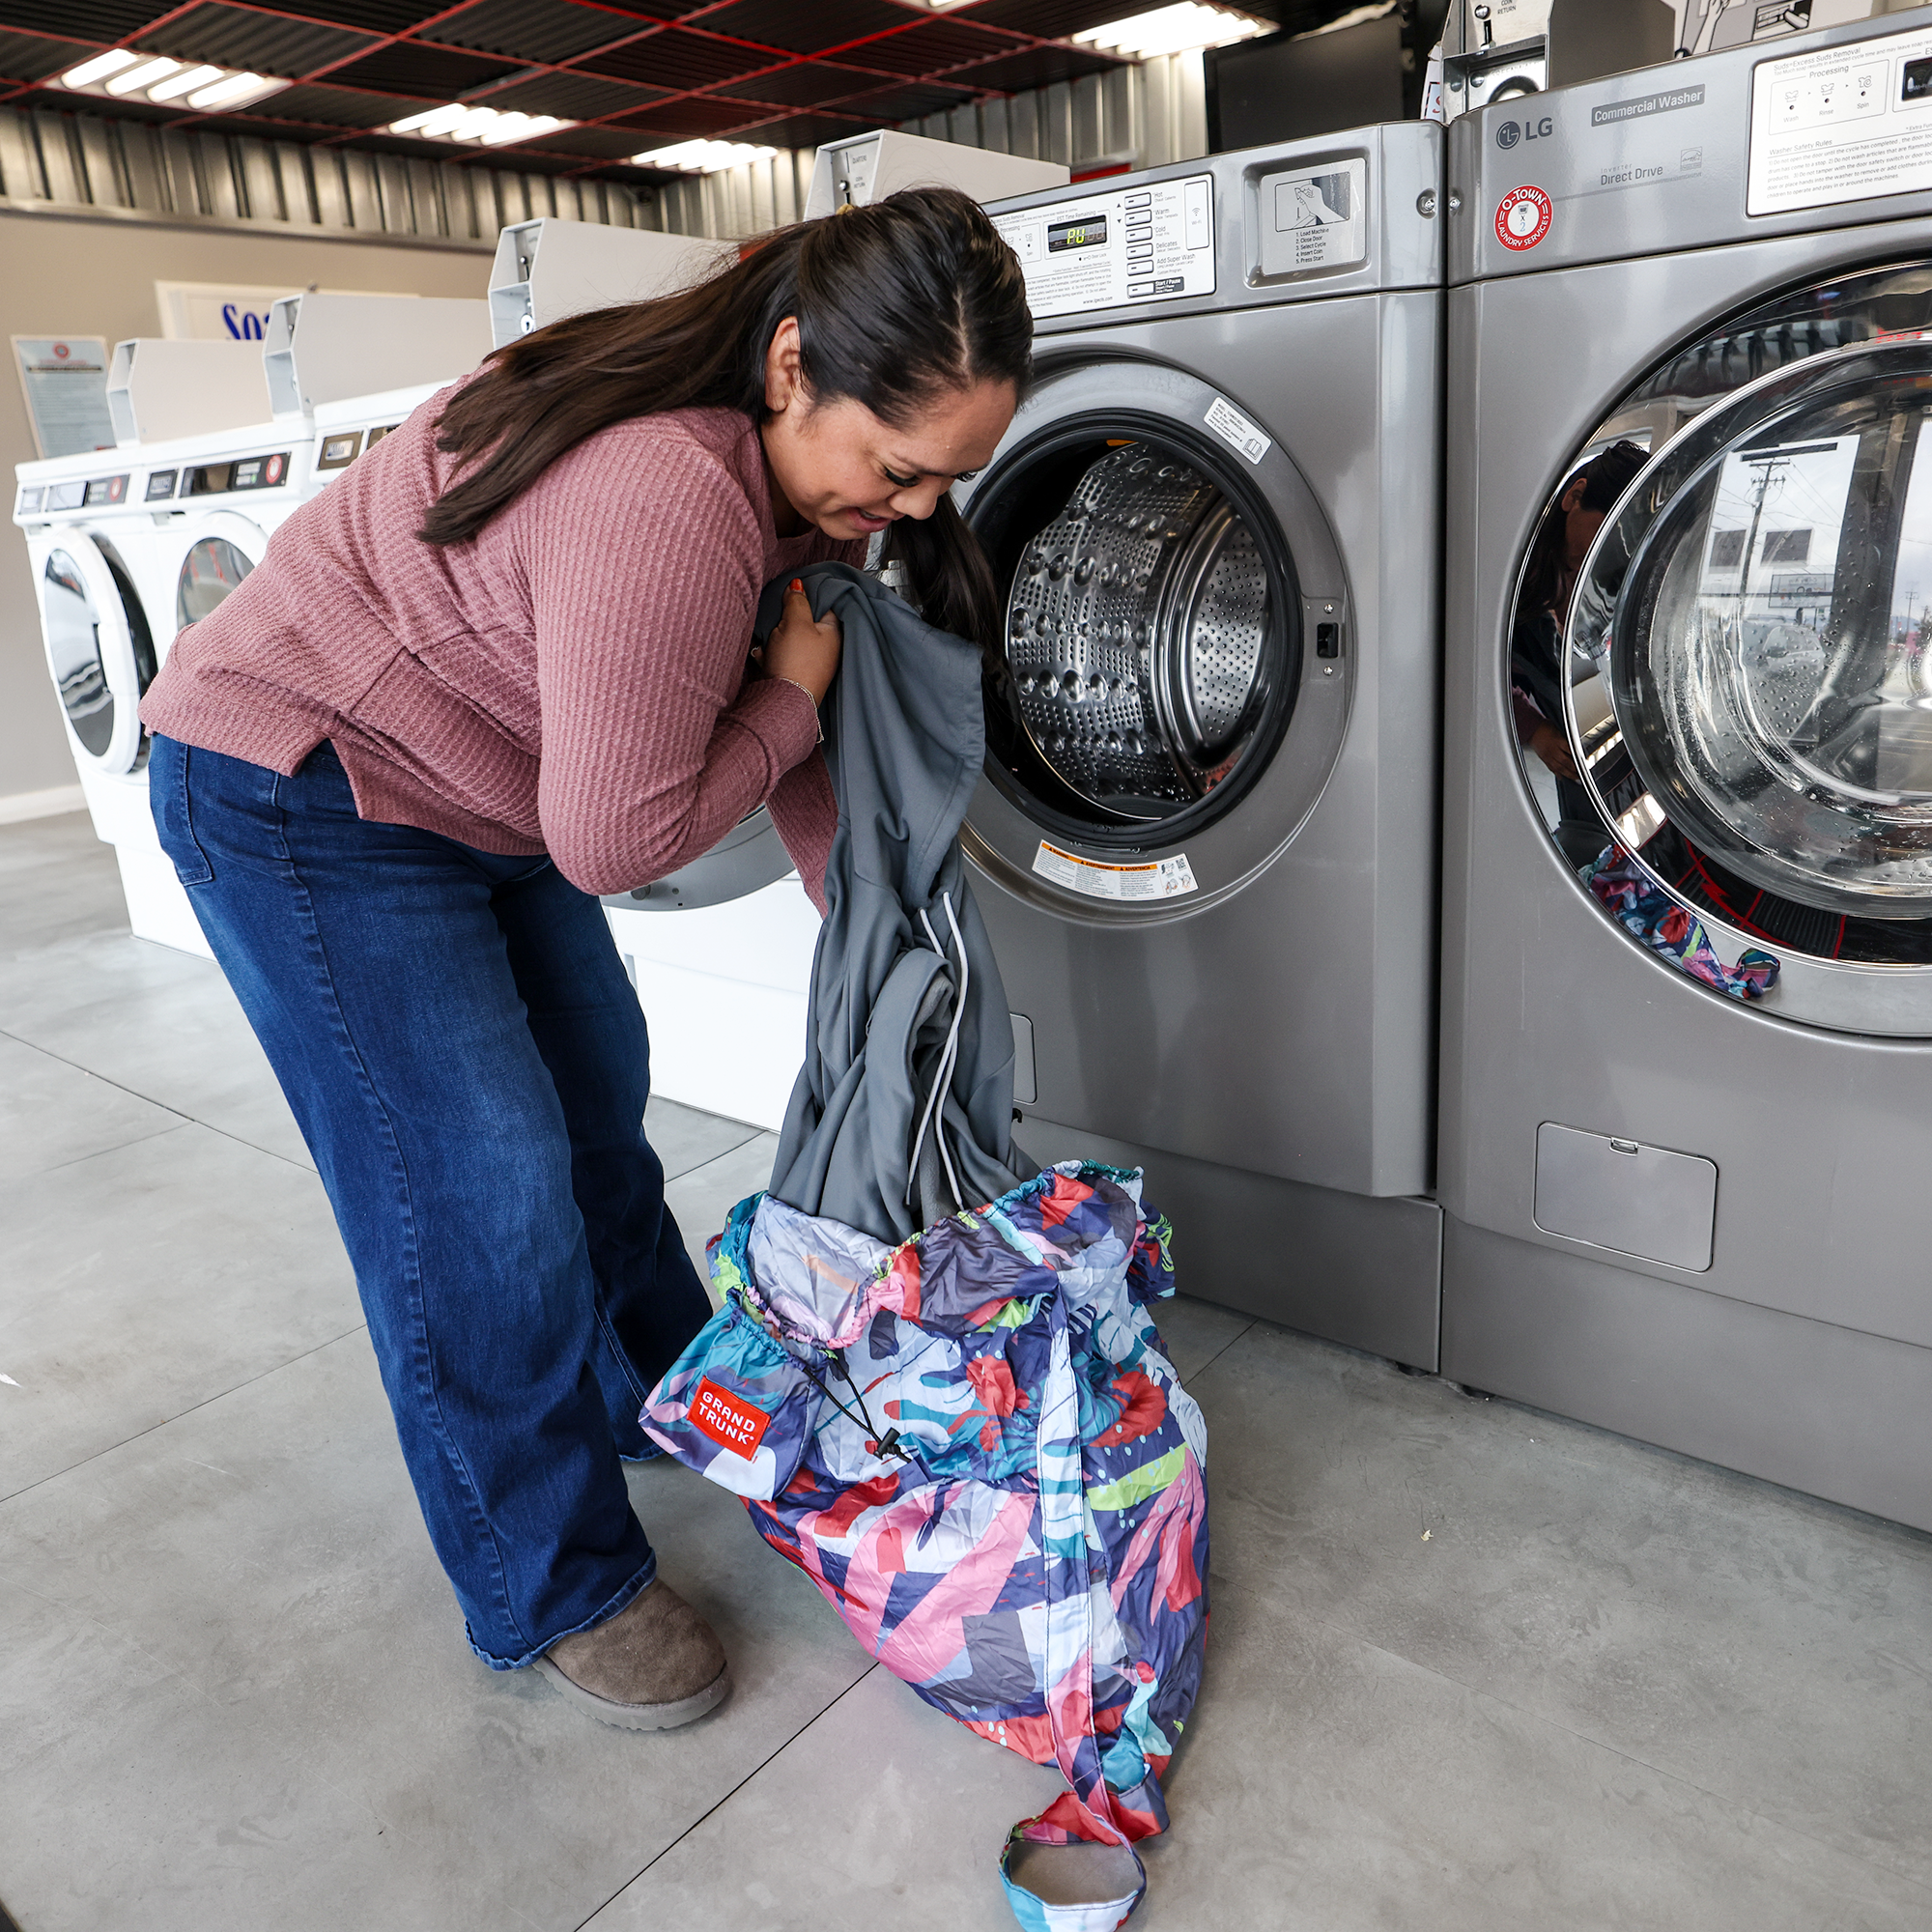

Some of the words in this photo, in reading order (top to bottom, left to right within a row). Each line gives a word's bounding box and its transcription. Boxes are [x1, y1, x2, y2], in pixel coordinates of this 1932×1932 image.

[1497, 5, 1517, 14] RETURN
[1816, 53, 1833, 63] Suds
[1833, 47, 1861, 59] Removal
[1809, 65, 1849, 78] Processing
[1594, 99, 1657, 123] Commercial
[1659, 89, 1703, 108] Washer
[1524, 117, 1553, 141] LG
[1794, 143, 1814, 152] Safety
[1601, 163, 1633, 174] Inverter
[1601, 171, 1633, 185] Direct
[1634, 166, 1663, 180] Drive
[1502, 188, 1548, 211] O-TOWN
[1497, 221, 1523, 247] LAUNDRY
[1523, 215, 1549, 246] SERVICES
[1520, 221, 1526, 232] 2
[702, 1391, 756, 1433] GRAND
